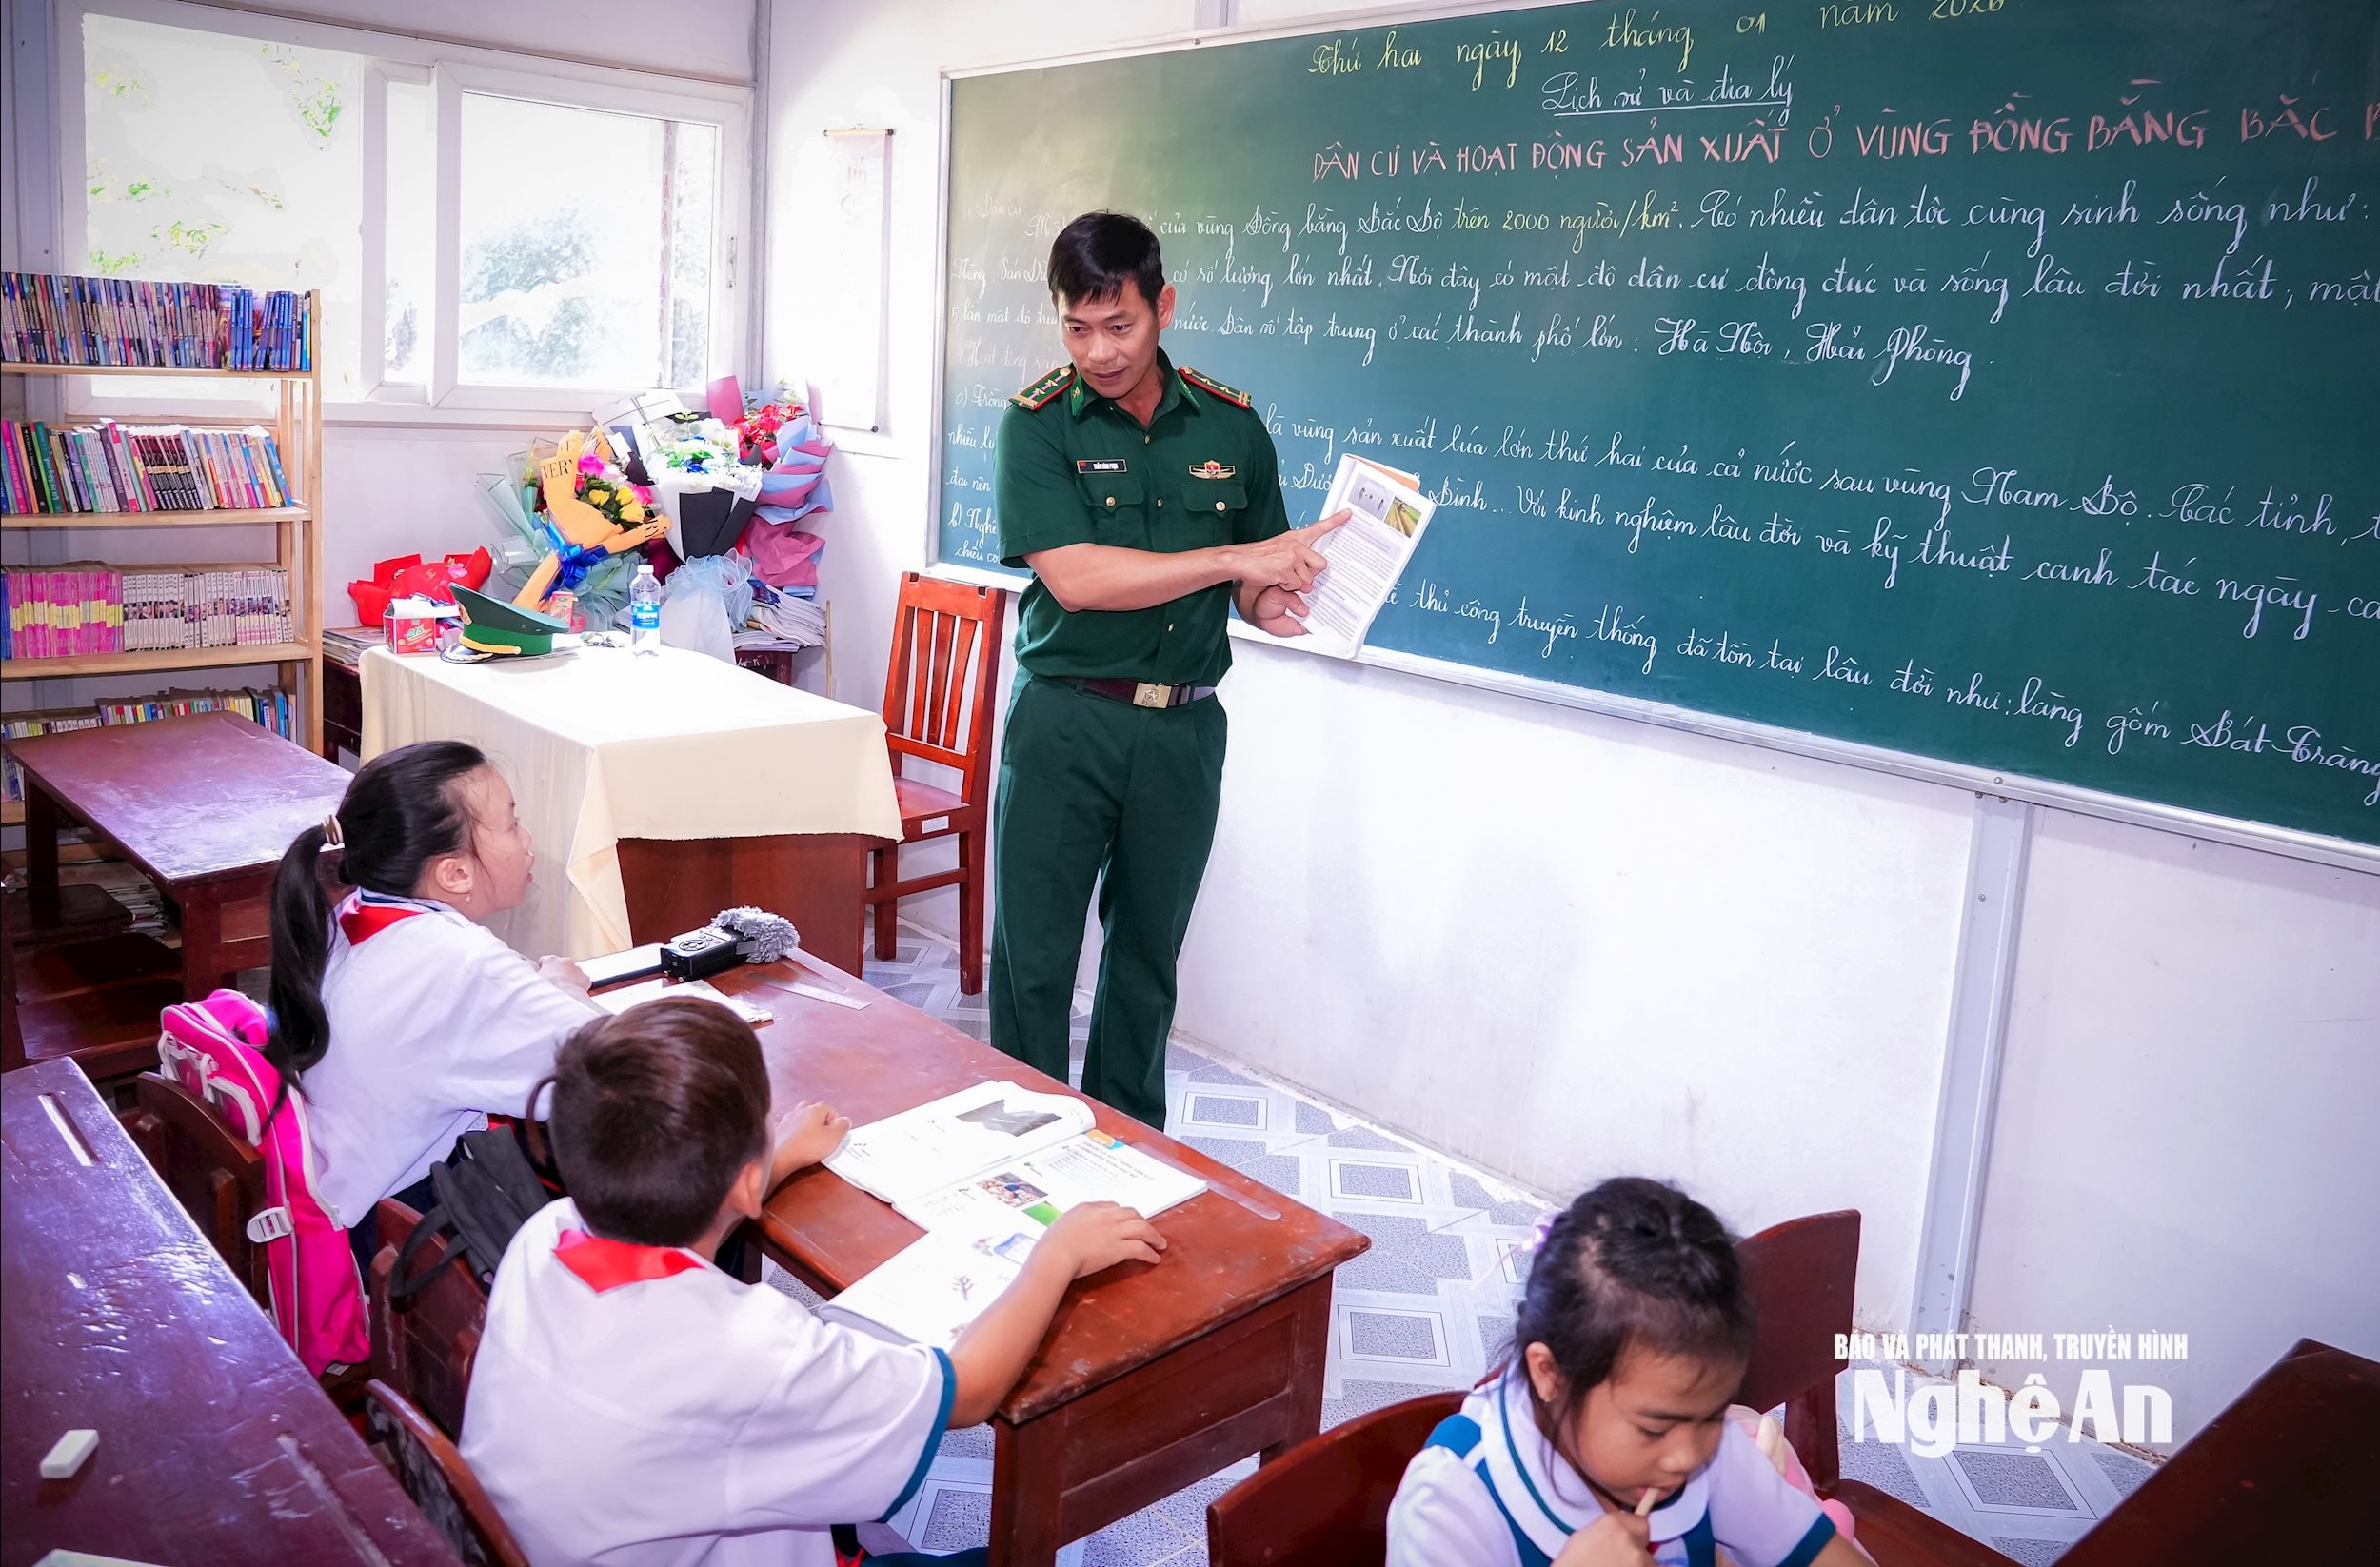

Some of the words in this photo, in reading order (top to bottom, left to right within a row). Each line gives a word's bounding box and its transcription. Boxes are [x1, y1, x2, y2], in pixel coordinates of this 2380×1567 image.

[1307, 30, 1361, 75] Thứ
[1376, 31, 1422, 69] hai
[1457, 30, 1521, 91] ngày
[1541, 30, 1568, 53] 12
[1599, 9, 1694, 73] tháng
[1736, 12, 1765, 34] 01
[1313, 141, 1359, 183] DÂN
[1372, 144, 1399, 176] CƯ
[1413, 141, 1446, 175] VÀ
[1457, 143, 1517, 175] HOẠT
[1533, 130, 1607, 179] ĐỘNG
[1622, 117, 1682, 167] SẢN
[1700, 107, 1789, 163] XUẤT
[1856, 108, 1953, 159] VÙNG
[1969, 92, 2073, 154] ĐỒNG
[2088, 79, 2209, 152] BẰNG
[2242, 69, 2336, 142] BẮC
[1657, 80, 1695, 105] và
[1160, 213, 1186, 234] của
[1196, 216, 1236, 258] vùng
[1297, 203, 1348, 256] bằng
[1450, 197, 1490, 229] trên
[1502, 210, 1549, 230] 2000
[1750, 188, 1826, 228] nhiều
[1839, 186, 1898, 225] dân
[1961, 197, 2047, 258] cùng
[2061, 180, 2140, 225] sinh
[2156, 176, 2247, 254] sống
[1169, 260, 1189, 283] có
[1196, 260, 1218, 283] số
[1220, 253, 1273, 308] lượng
[1283, 253, 1315, 286] lớn
[1441, 262, 1481, 311] đây
[1489, 260, 1514, 288] có
[1524, 260, 1571, 289] mật
[1628, 257, 1682, 289] dân
[1735, 251, 1806, 320] đông
[1822, 257, 1877, 293] đúc
[1894, 269, 1927, 293] và
[1940, 250, 2009, 324] sống
[2022, 254, 2086, 297] lâu
[2105, 260, 2161, 297] đời
[960, 297, 982, 323] lần
[986, 305, 1010, 327] mật
[1015, 303, 1031, 327] độ
[1282, 308, 1313, 345] tập
[1323, 312, 1376, 366] trung
[1404, 312, 1441, 341] các
[1445, 311, 1522, 350] thành
[1531, 313, 1580, 363] phố
[971, 475, 992, 492] nên
[1292, 419, 1333, 465] vùng
[1342, 418, 1382, 445] sản
[1391, 416, 1436, 448] xuất
[1440, 424, 1487, 455] lúa
[1494, 426, 1533, 458] lớn
[1538, 429, 1588, 462] thứ
[1594, 432, 1645, 466] hai
[1651, 445, 1698, 474] của
[1706, 448, 1745, 477] cả
[1754, 441, 1812, 484] nước
[1819, 468, 1875, 493] sau
[1882, 468, 1951, 531] vùng
[1961, 467, 2068, 508] Nam
[1517, 486, 1546, 517] Với
[1555, 488, 1605, 525] kinh
[1616, 496, 1697, 553] nghiệm
[1700, 504, 1751, 542] lâu
[1759, 512, 1801, 545] đời
[1815, 530, 1851, 554] và
[1861, 517, 1908, 589] kỹ
[1907, 529, 2014, 577] thuật
[2020, 548, 2119, 585] canh
[2127, 551, 2200, 595] tác
[2216, 576, 2318, 640] ngày
[1454, 599, 1500, 644] công
[1508, 596, 1578, 658] truyền
[1586, 604, 1657, 674] thống
[1677, 628, 1713, 657] đã
[1712, 631, 1755, 667] tồn
[1759, 639, 1804, 678] tại
[1813, 646, 1873, 685] lâu
[1890, 659, 1934, 696] đời
[2013, 677, 2083, 747] làng
[2106, 701, 2171, 755] gốm
